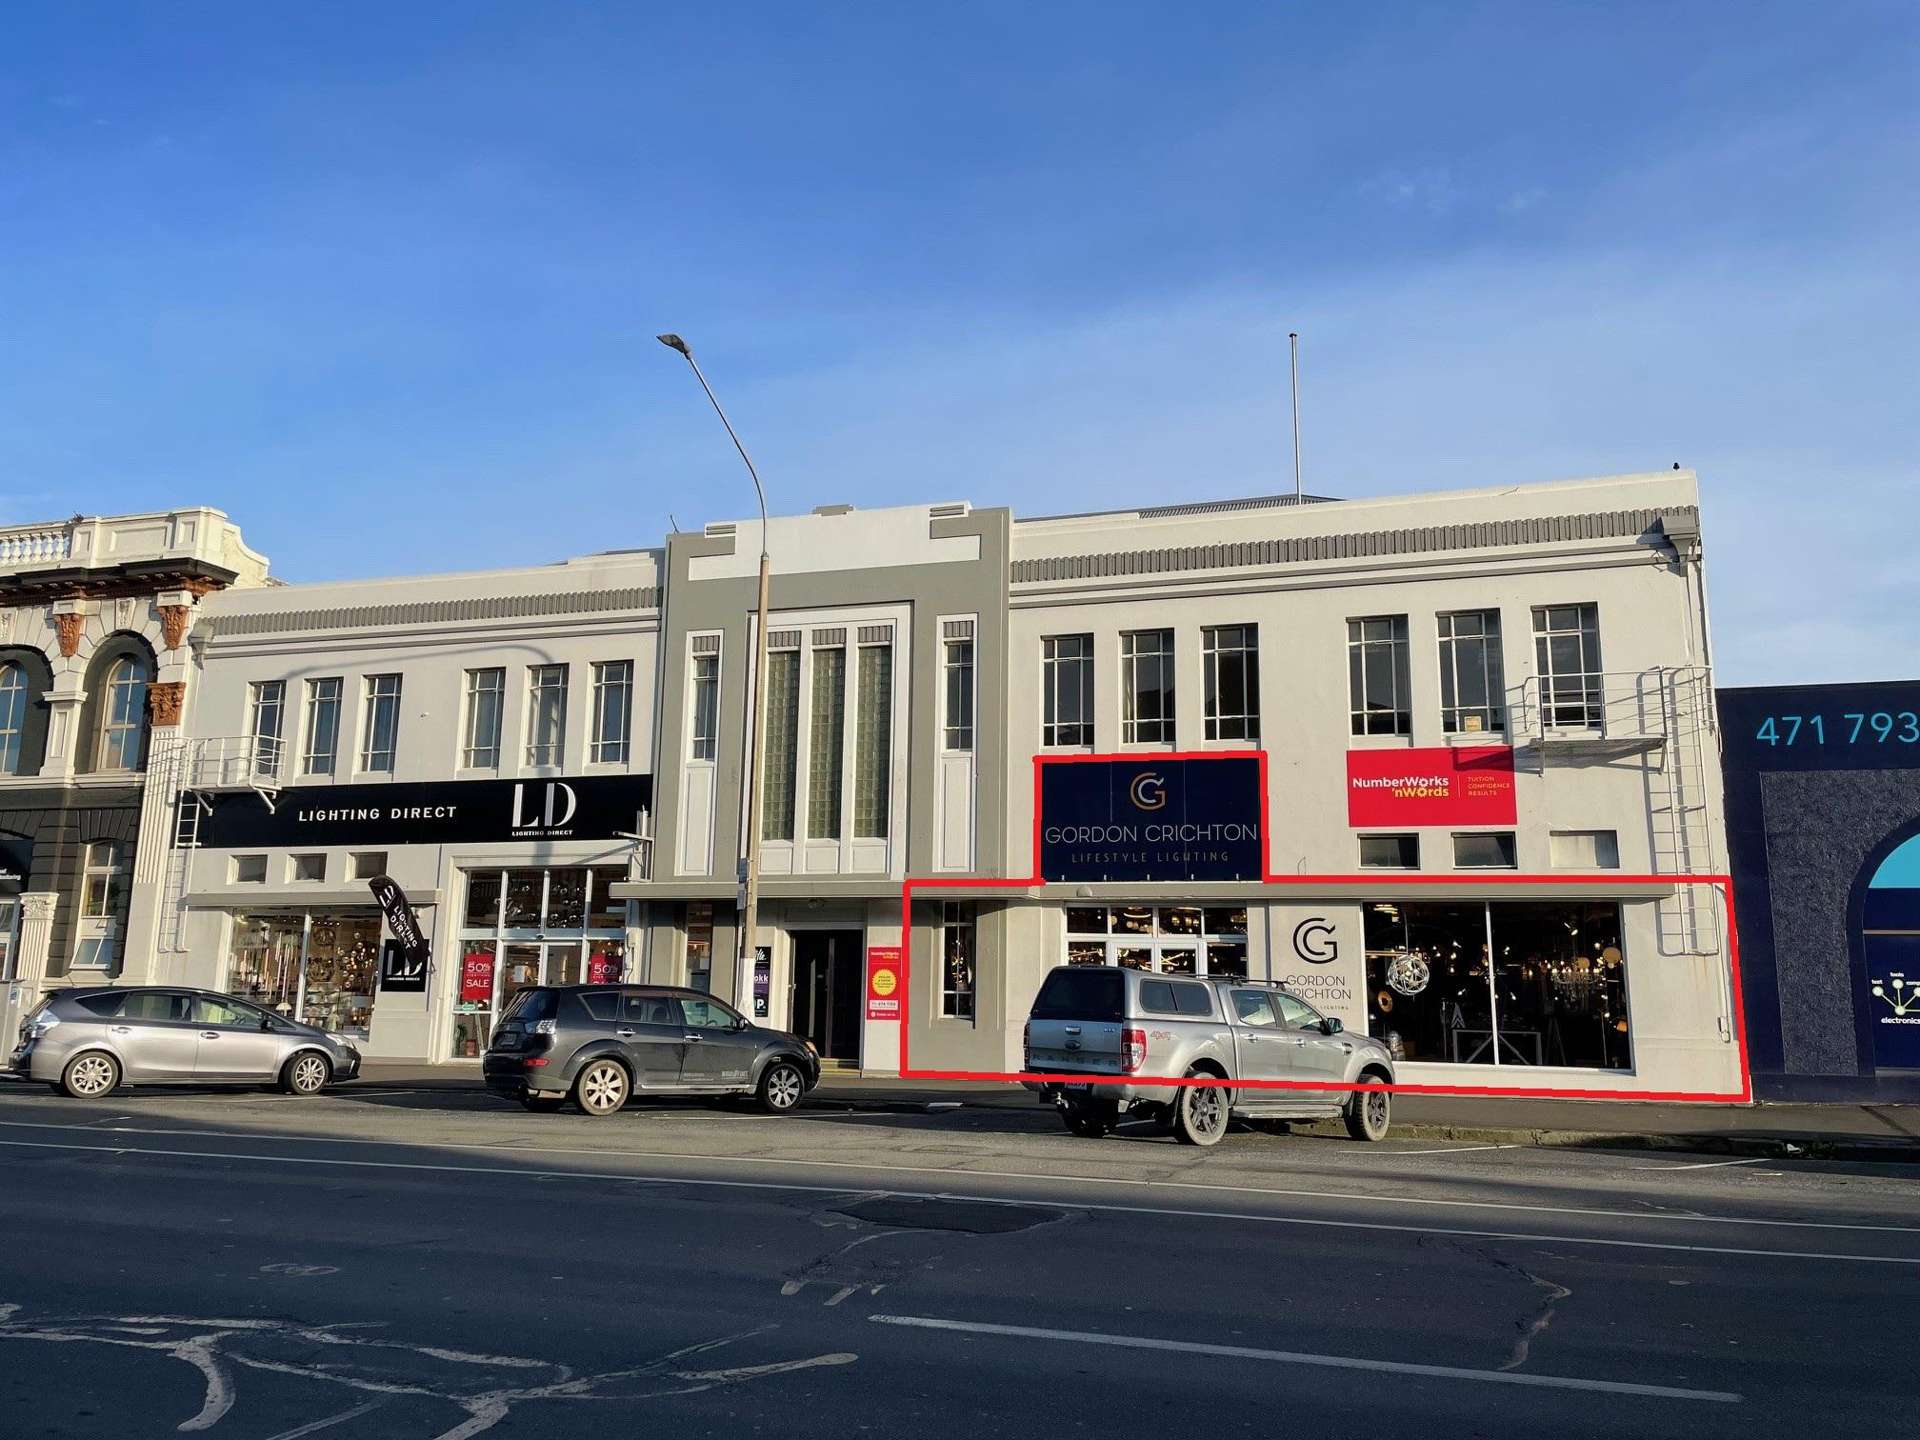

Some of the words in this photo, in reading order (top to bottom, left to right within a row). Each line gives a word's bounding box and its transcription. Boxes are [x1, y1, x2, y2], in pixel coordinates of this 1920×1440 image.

[1756, 715, 1825, 746] 471
[1353, 776, 1449, 788] NumberWorks
[512, 782, 577, 828] LD
[298, 808, 380, 822] LIGHTING
[391, 806, 457, 819] DIRECT
[1045, 825, 1137, 844] GORDON
[1145, 823, 1257, 842] CRICHTON
[1071, 851, 1148, 864] LIFESTYLE
[1157, 851, 1230, 863] LIGHTING
[466, 979, 489, 988] SALE
[1286, 974, 1346, 986] GORDON
